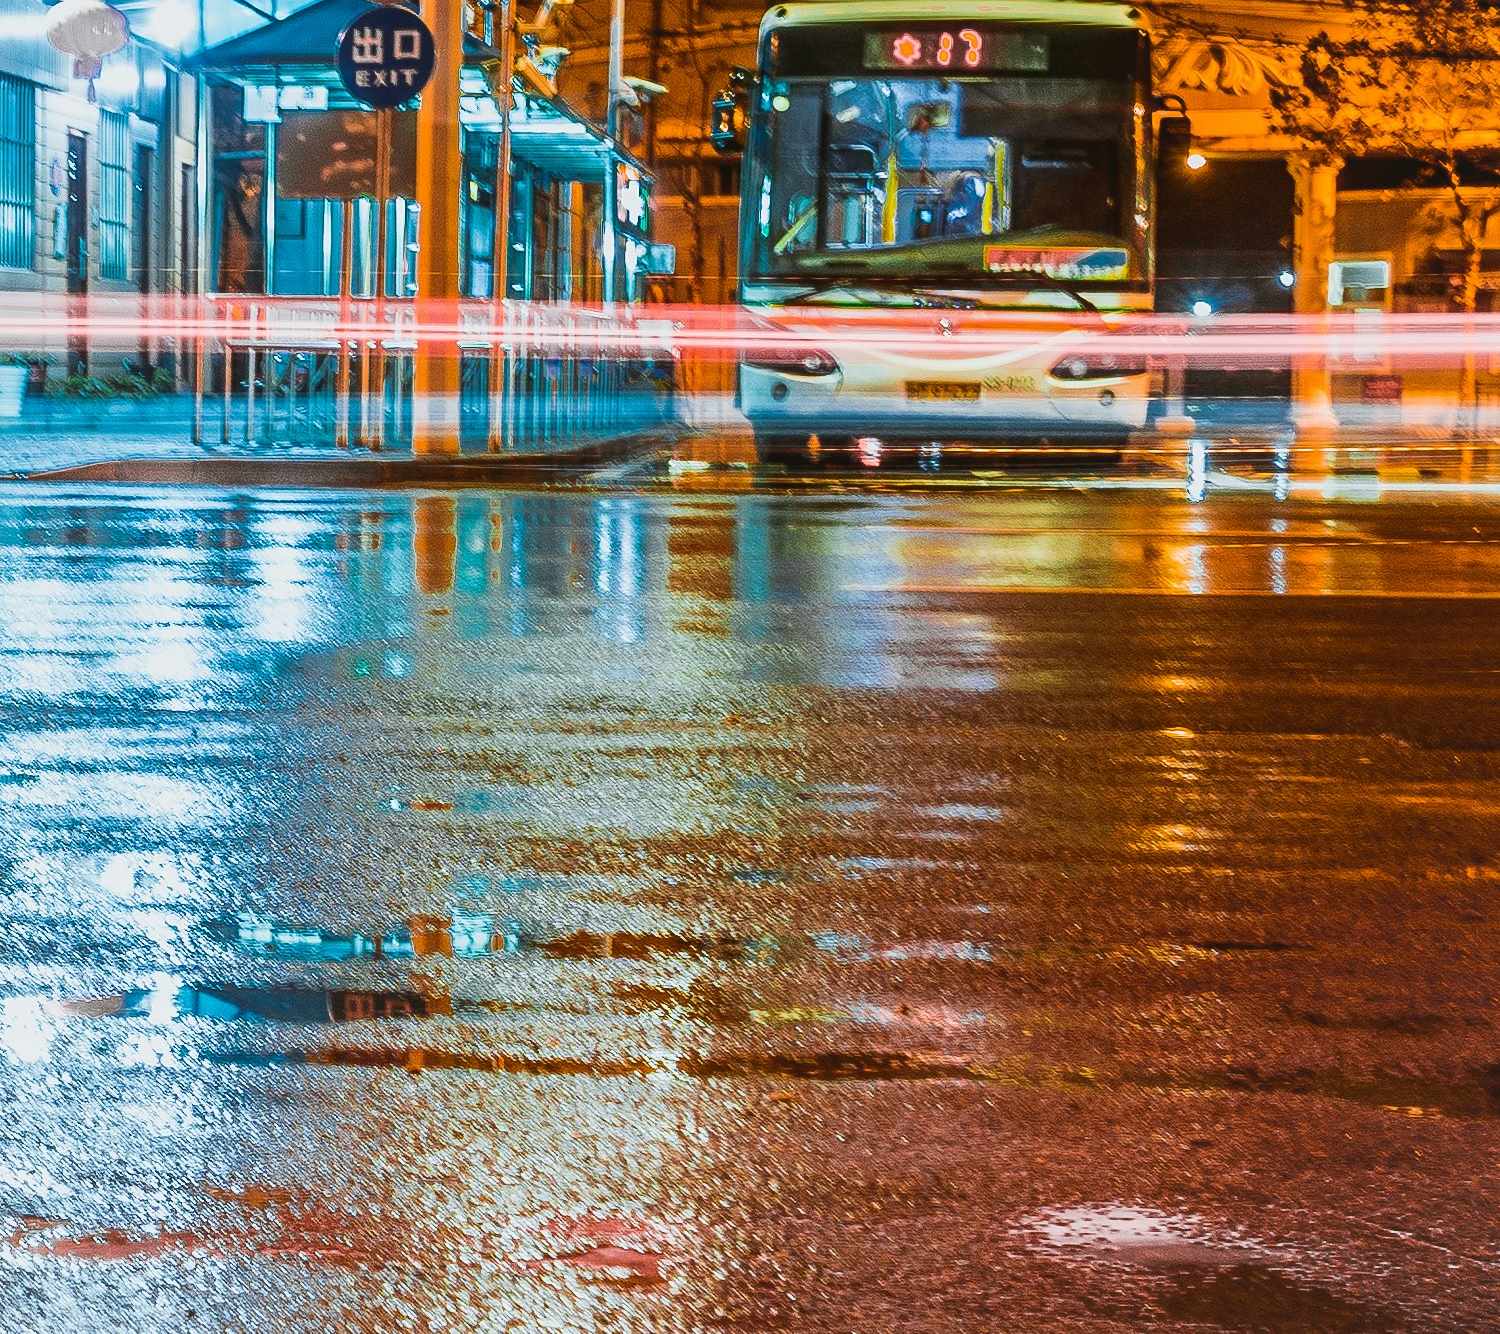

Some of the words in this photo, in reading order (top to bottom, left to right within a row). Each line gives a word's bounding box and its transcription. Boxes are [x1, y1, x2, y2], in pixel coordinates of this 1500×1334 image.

[352, 27, 420, 64] 出口
[937, 30, 982, 66] 17
[355, 69, 418, 87] EXIT
